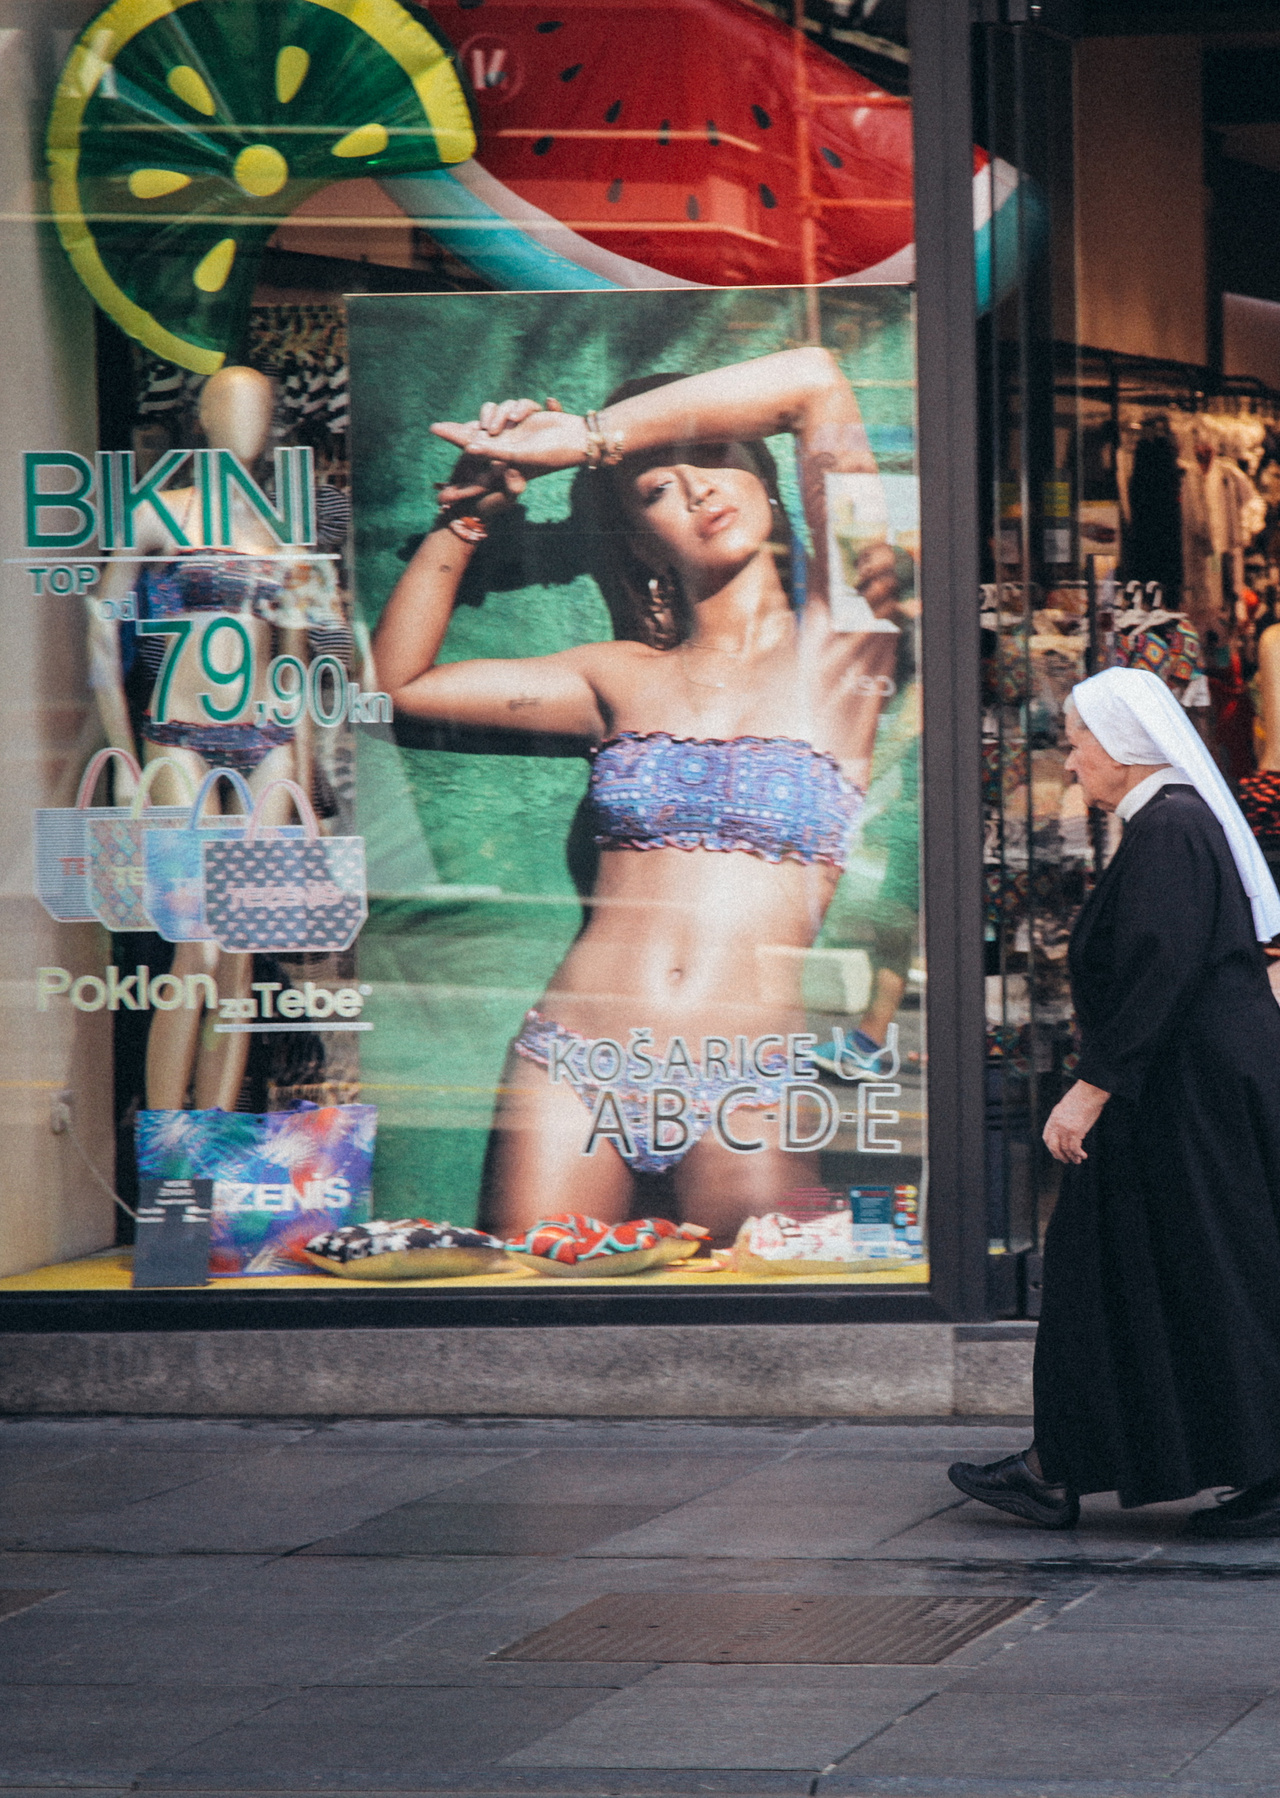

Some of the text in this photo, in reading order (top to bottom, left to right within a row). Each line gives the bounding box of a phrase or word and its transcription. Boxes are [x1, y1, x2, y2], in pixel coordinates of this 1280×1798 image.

[22, 446, 316, 551] BIKINI
[26, 565, 100, 596] TOP
[36, 964, 219, 1013] Poklon
[547, 1027, 820, 1085] KOŠARICE
